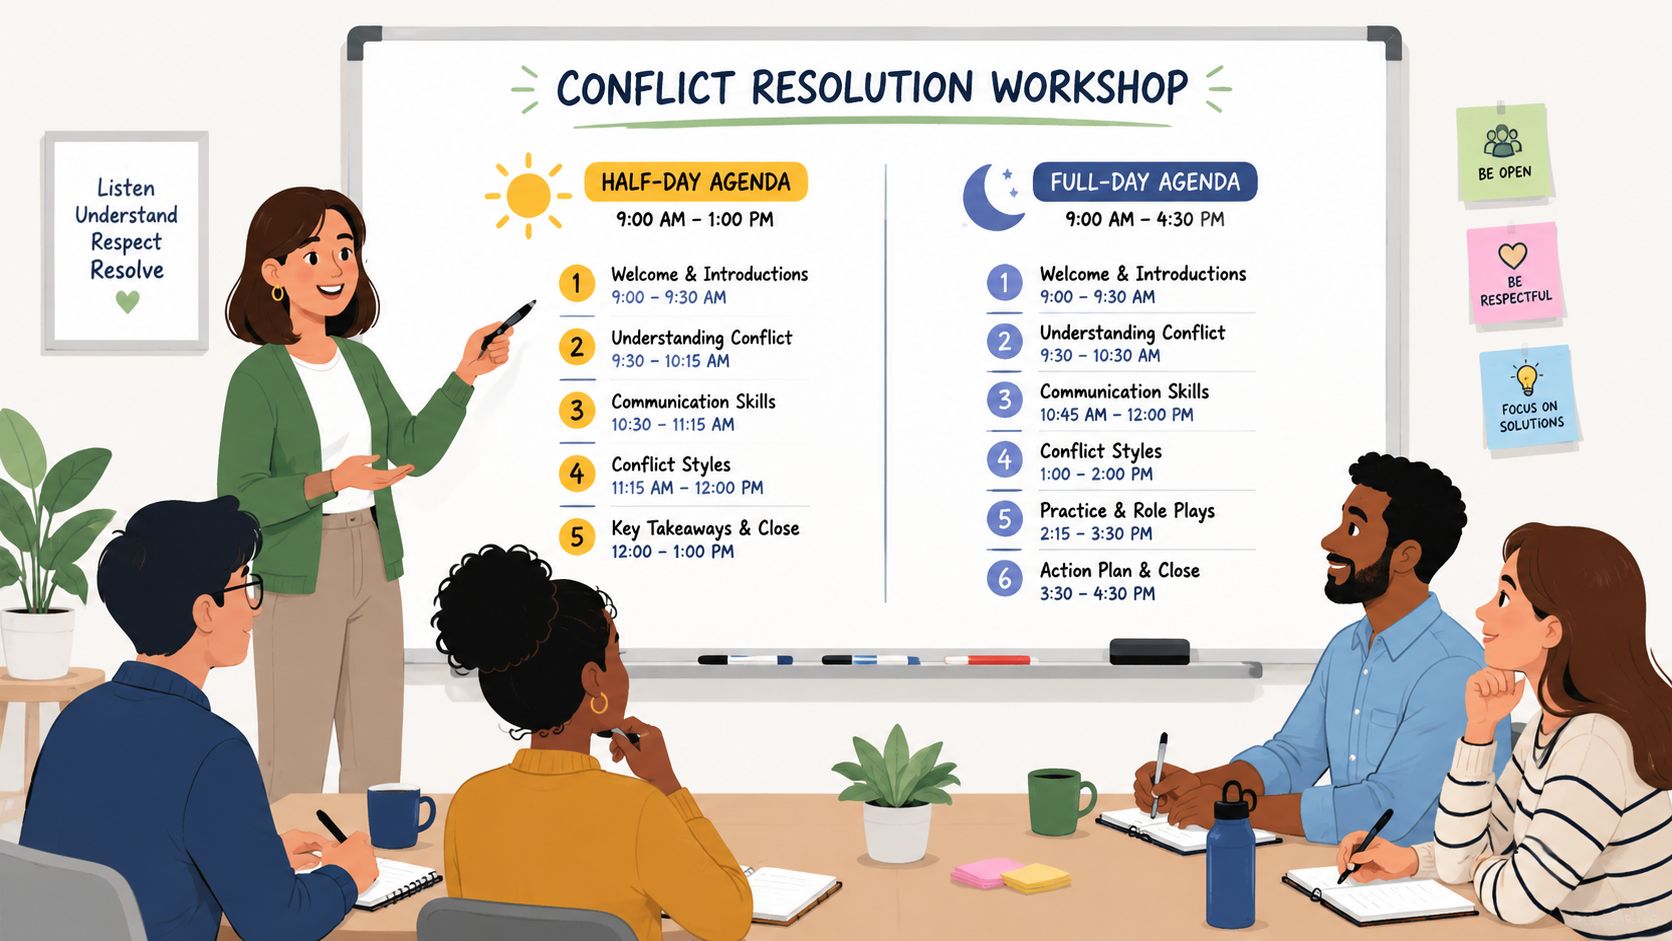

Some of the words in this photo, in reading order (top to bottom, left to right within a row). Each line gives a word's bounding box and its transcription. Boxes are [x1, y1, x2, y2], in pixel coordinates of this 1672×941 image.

[557, 70, 736, 106] CONFLICT
[753, 69, 973, 105] RESOLUTION
[992, 69, 1188, 105] WORKSHOP
[602, 172, 701, 191] HALF-DAY
[710, 172, 791, 192] AGENDA
[1052, 172, 1149, 191] FULL-DAY
[1159, 172, 1240, 191] AGENDA
[1479, 167, 1494, 180] BE
[1500, 166, 1531, 178] OPEN
[98, 177, 154, 197] Listen
[76, 205, 177, 223] Understand
[617, 211, 653, 227] 9:00
[660, 211, 685, 227] AM
[708, 212, 742, 227] 1:00
[750, 211, 773, 227] PM
[1066, 211, 1102, 227] 9:00
[1109, 211, 1134, 227] AM
[1157, 211, 1193, 227] 4:30
[1201, 211, 1224, 227] PM
[92, 232, 162, 256] Respect
[91, 259, 164, 280] Resolve
[611, 266, 678, 282] Welcome
[685, 265, 696, 282] &
[704, 265, 808, 281] Introductions
[1040, 265, 1110, 281] Welcome
[1117, 265, 1128, 281] &
[1136, 265, 1246, 281] Introductions
[572, 272, 581, 294] 1
[1000, 272, 1008, 293] 1
[1508, 276, 1522, 288] BE
[612, 290, 644, 304] 9:00
[665, 290, 698, 304] 9:30
[704, 290, 726, 304] AM
[1041, 290, 1073, 304] 9:00
[1094, 289, 1126, 303] 9:30
[1132, 289, 1155, 304] AM
[1481, 290, 1552, 306] RESPECTFUL
[612, 329, 724, 350] Understanding
[731, 329, 793, 346] Conflict
[998, 331, 1012, 352] 2
[1041, 324, 1155, 345] Understanding
[1162, 324, 1226, 341] Conflict
[570, 336, 584, 357] 2
[1041, 348, 1072, 362] 9:30
[1094, 348, 1132, 362] 10:30
[1138, 348, 1160, 362] AM
[612, 354, 644, 368] 9:30
[665, 354, 700, 368] 10:15
[707, 354, 729, 368] AM
[999, 388, 1012, 410] 3
[1040, 383, 1161, 399] Communication
[1168, 383, 1209, 399] Skills
[570, 399, 584, 421] 3
[612, 393, 729, 409] Communication
[736, 393, 776, 409] Skills
[1503, 403, 1537, 415] FOCUS
[1542, 401, 1557, 412] ON
[1041, 407, 1078, 421] 10:45
[1085, 407, 1107, 421] AM
[1128, 408, 1166, 421] 12:00
[1172, 407, 1193, 421] PM
[612, 417, 651, 431] 10:30
[673, 417, 705, 431] 11:15
[712, 417, 734, 431] AM
[997, 448, 1012, 470] 4
[1040, 442, 1105, 459] Conflict
[1112, 442, 1162, 464] Styles
[569, 462, 585, 485] 4
[612, 455, 675, 473] Conflict
[682, 456, 731, 477] Styles
[1041, 467, 1070, 481] 1:00
[1092, 467, 1125, 481] 2:00
[1132, 467, 1153, 481] PM
[612, 481, 644, 495] 11:15
[651, 480, 673, 495] AM
[696, 481, 735, 494] 12:00
[742, 480, 763, 495] PM
[999, 508, 1012, 530] 5
[1041, 502, 1107, 518] Practice
[1114, 501, 1126, 518] &
[1134, 502, 1167, 518] Role
[1174, 502, 1215, 523] Plays
[571, 526, 584, 548] 5
[612, 520, 640, 540] Key
[647, 519, 732, 540] Takeaways
[739, 519, 751, 536] &
[758, 519, 800, 536] Close
[1041, 527, 1070, 541] 2:15
[1092, 526, 1124, 541] 3:30
[1131, 526, 1152, 541] PM
[612, 544, 652, 558] 12:00
[674, 544, 705, 558] 1:00
[712, 544, 734, 559] PM
[998, 567, 1012, 590] 6
[1040, 562, 1091, 578] Action
[1099, 561, 1132, 578] Plan
[1139, 561, 1151, 578] &
[1158, 561, 1200, 578] Close
[1041, 586, 1072, 601] 3:30
[1093, 586, 1127, 601] 4:30
[1134, 586, 1155, 601] PM
